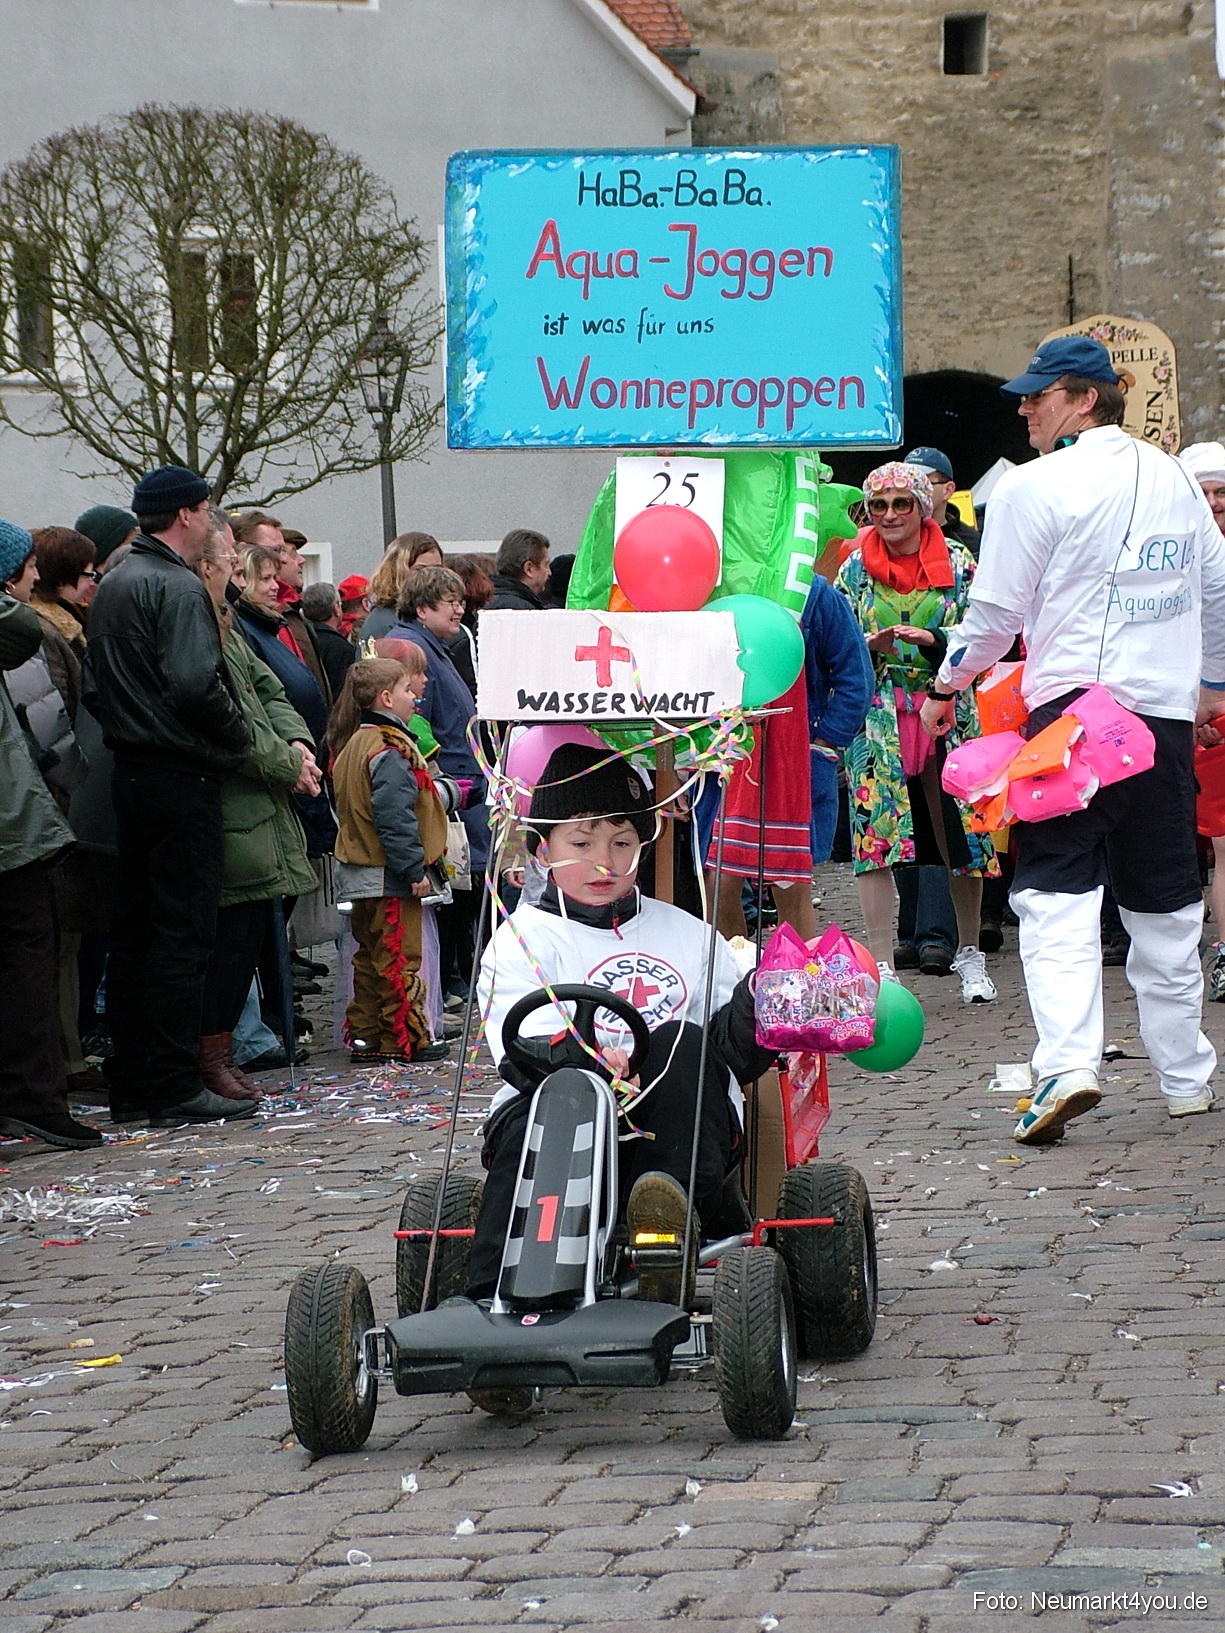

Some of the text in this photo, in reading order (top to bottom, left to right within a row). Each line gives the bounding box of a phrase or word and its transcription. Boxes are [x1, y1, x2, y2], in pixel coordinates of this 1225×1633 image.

[543, 307, 715, 343] ist was für uns
[536, 355, 866, 432] Wonneproppen
[645, 472, 699, 508] 25
[516, 688, 716, 714] WASSERWACHT
[601, 994, 673, 1026] WCHT
[536, 1195, 559, 1242] 1
